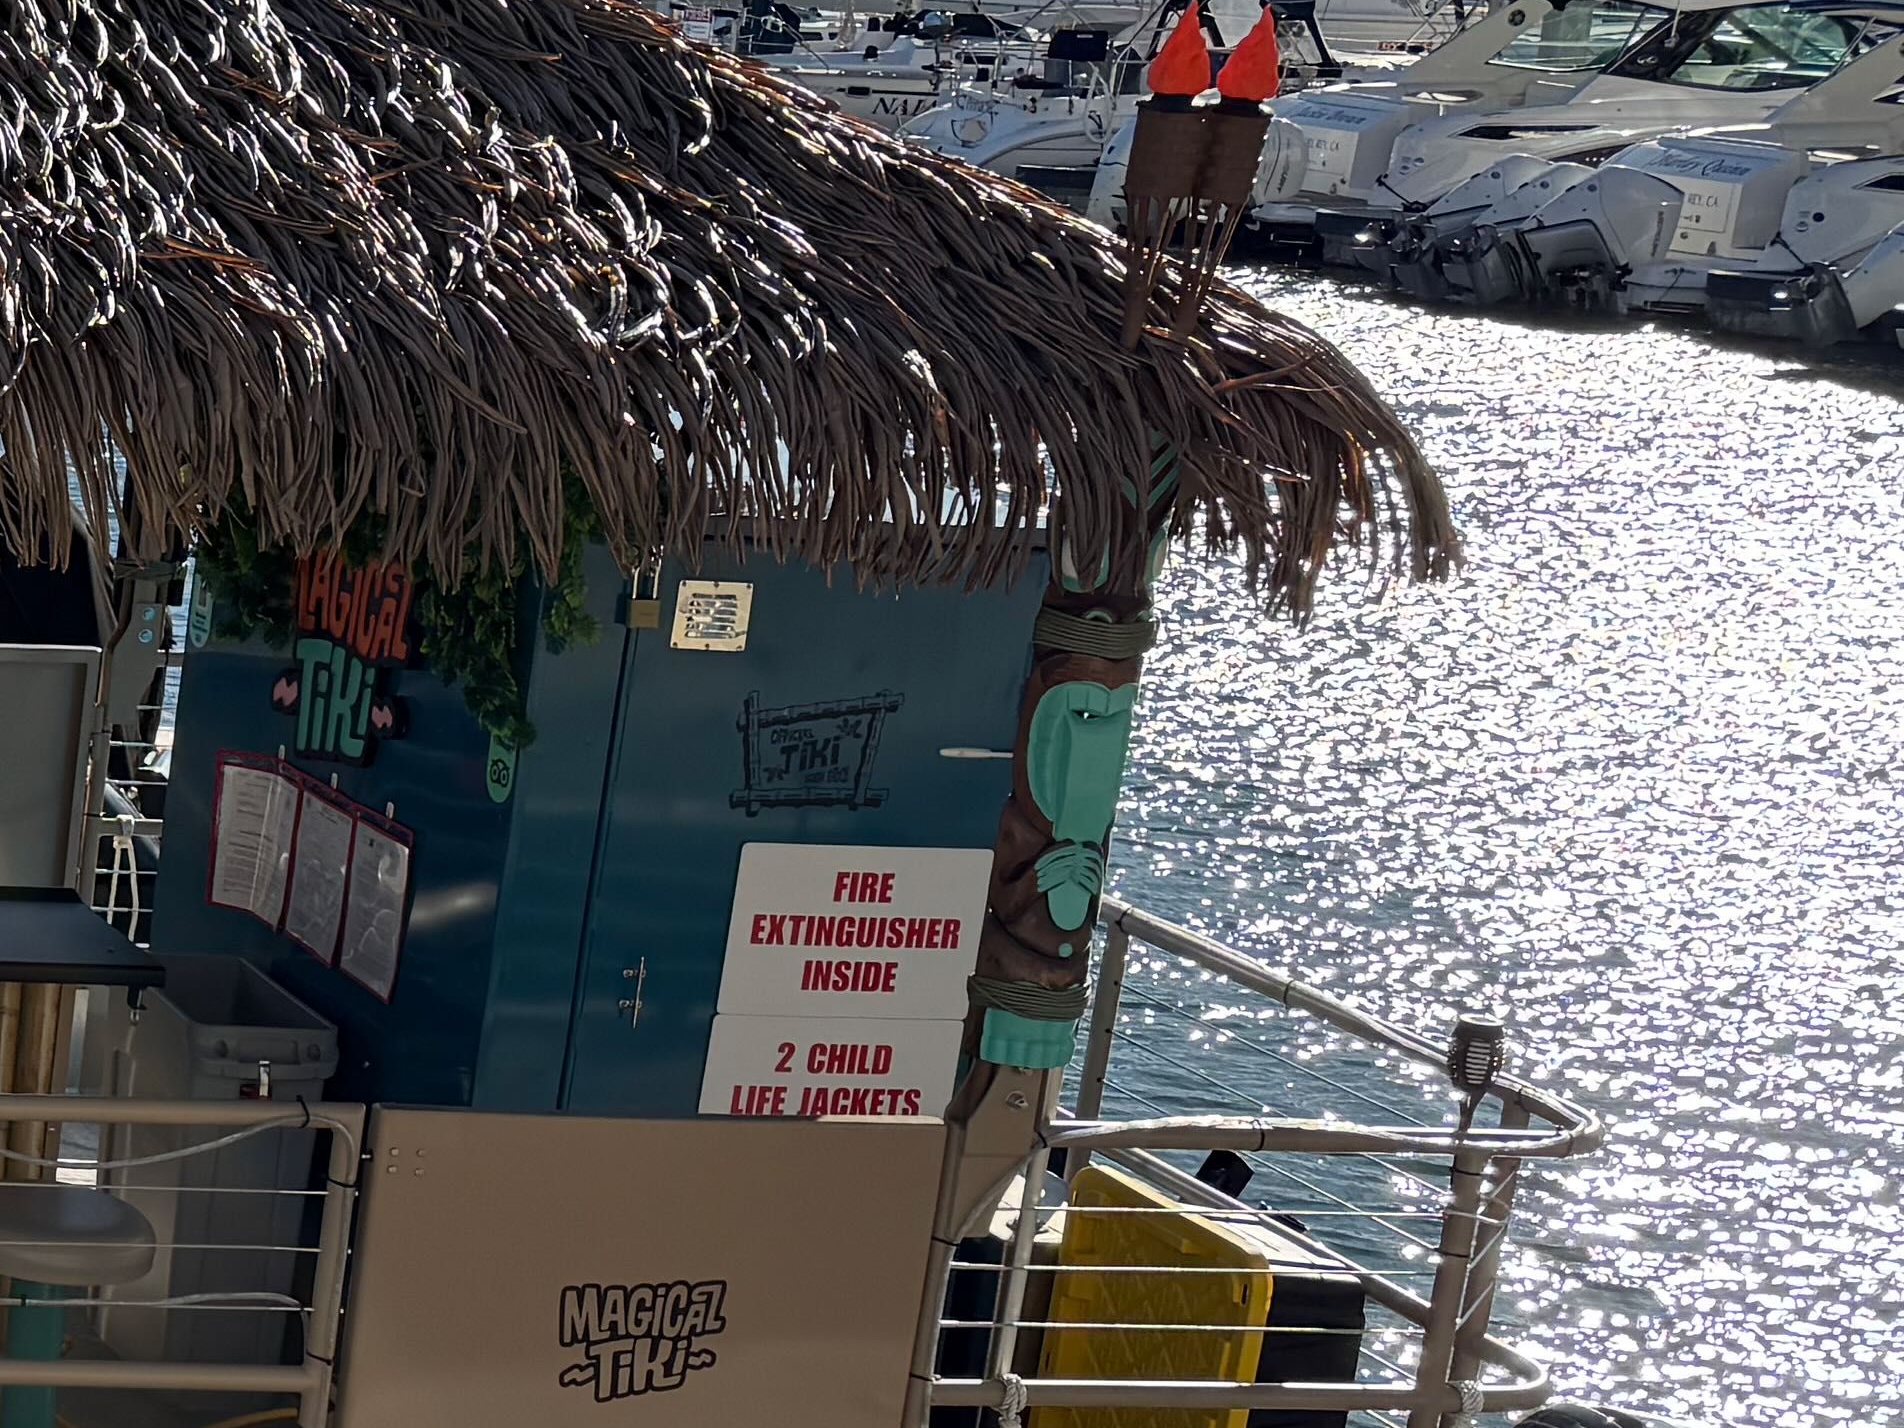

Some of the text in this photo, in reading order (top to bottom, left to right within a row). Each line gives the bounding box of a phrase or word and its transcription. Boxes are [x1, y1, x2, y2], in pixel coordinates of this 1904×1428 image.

[833, 872, 896, 904] FIRE
[750, 914, 961, 949] EXTINGUISHER
[801, 960, 899, 993] INSIDE
[775, 1042, 893, 1075] 2 CHILD
[730, 1085, 922, 1116] LIFE JACKETS
